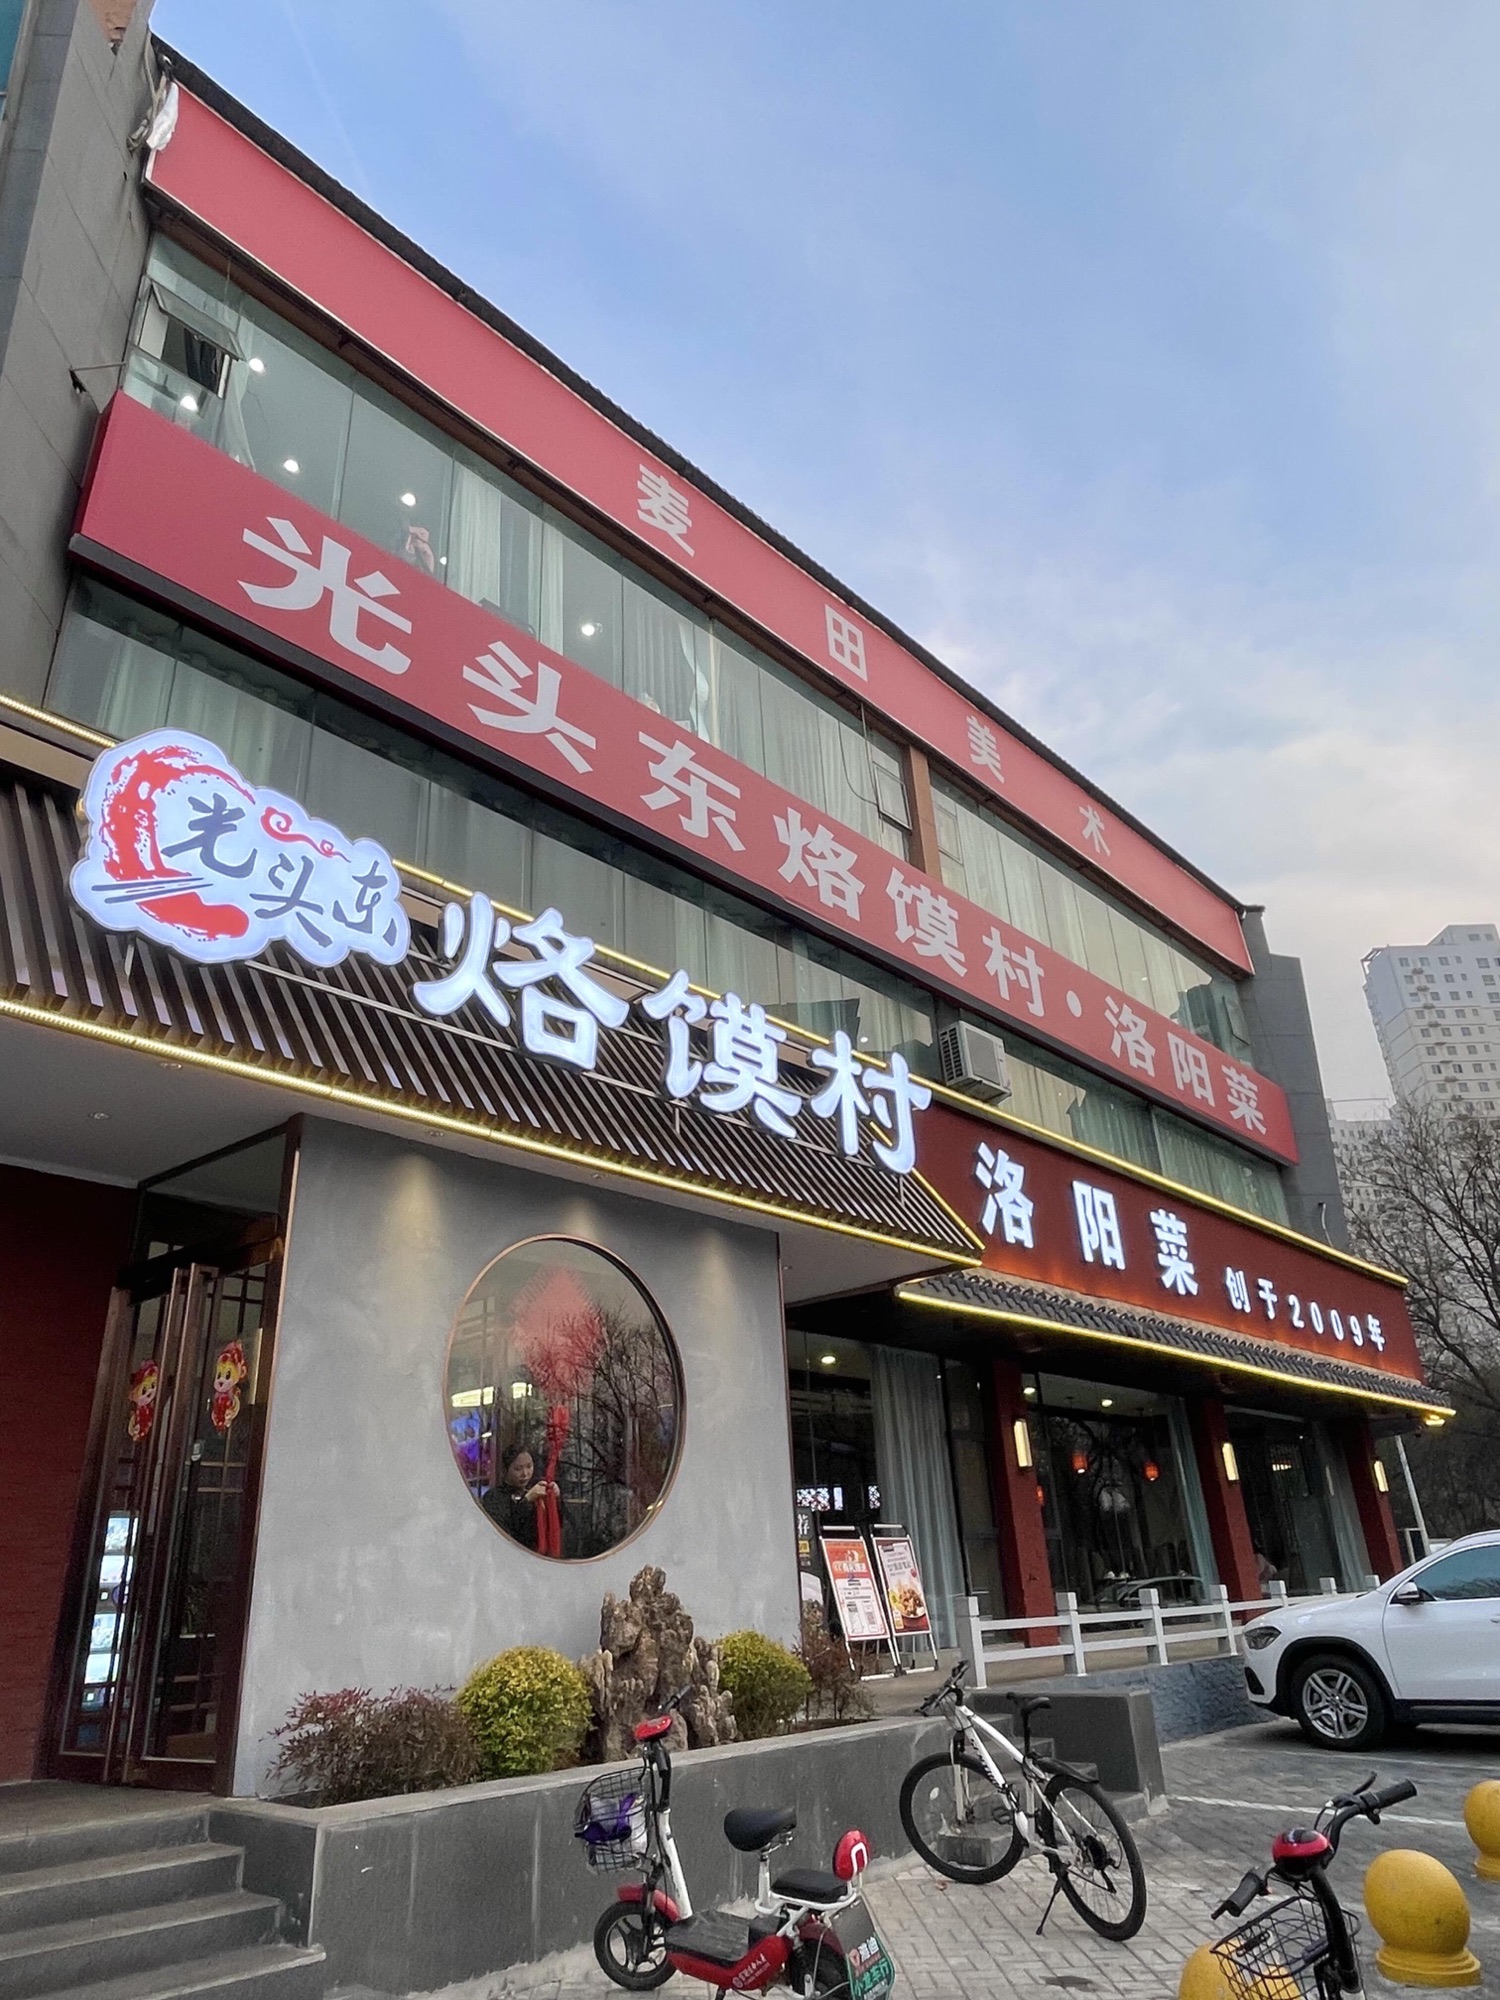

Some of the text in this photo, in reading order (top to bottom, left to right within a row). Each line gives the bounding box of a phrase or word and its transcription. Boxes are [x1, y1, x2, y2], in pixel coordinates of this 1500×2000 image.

[636, 464, 1112, 857] 麦田美术
[160, 793, 400, 949] 光头东
[413, 891, 932, 1175] 烙馍村
[975, 1142, 1386, 1352] 洛阳菜 创于2009年
